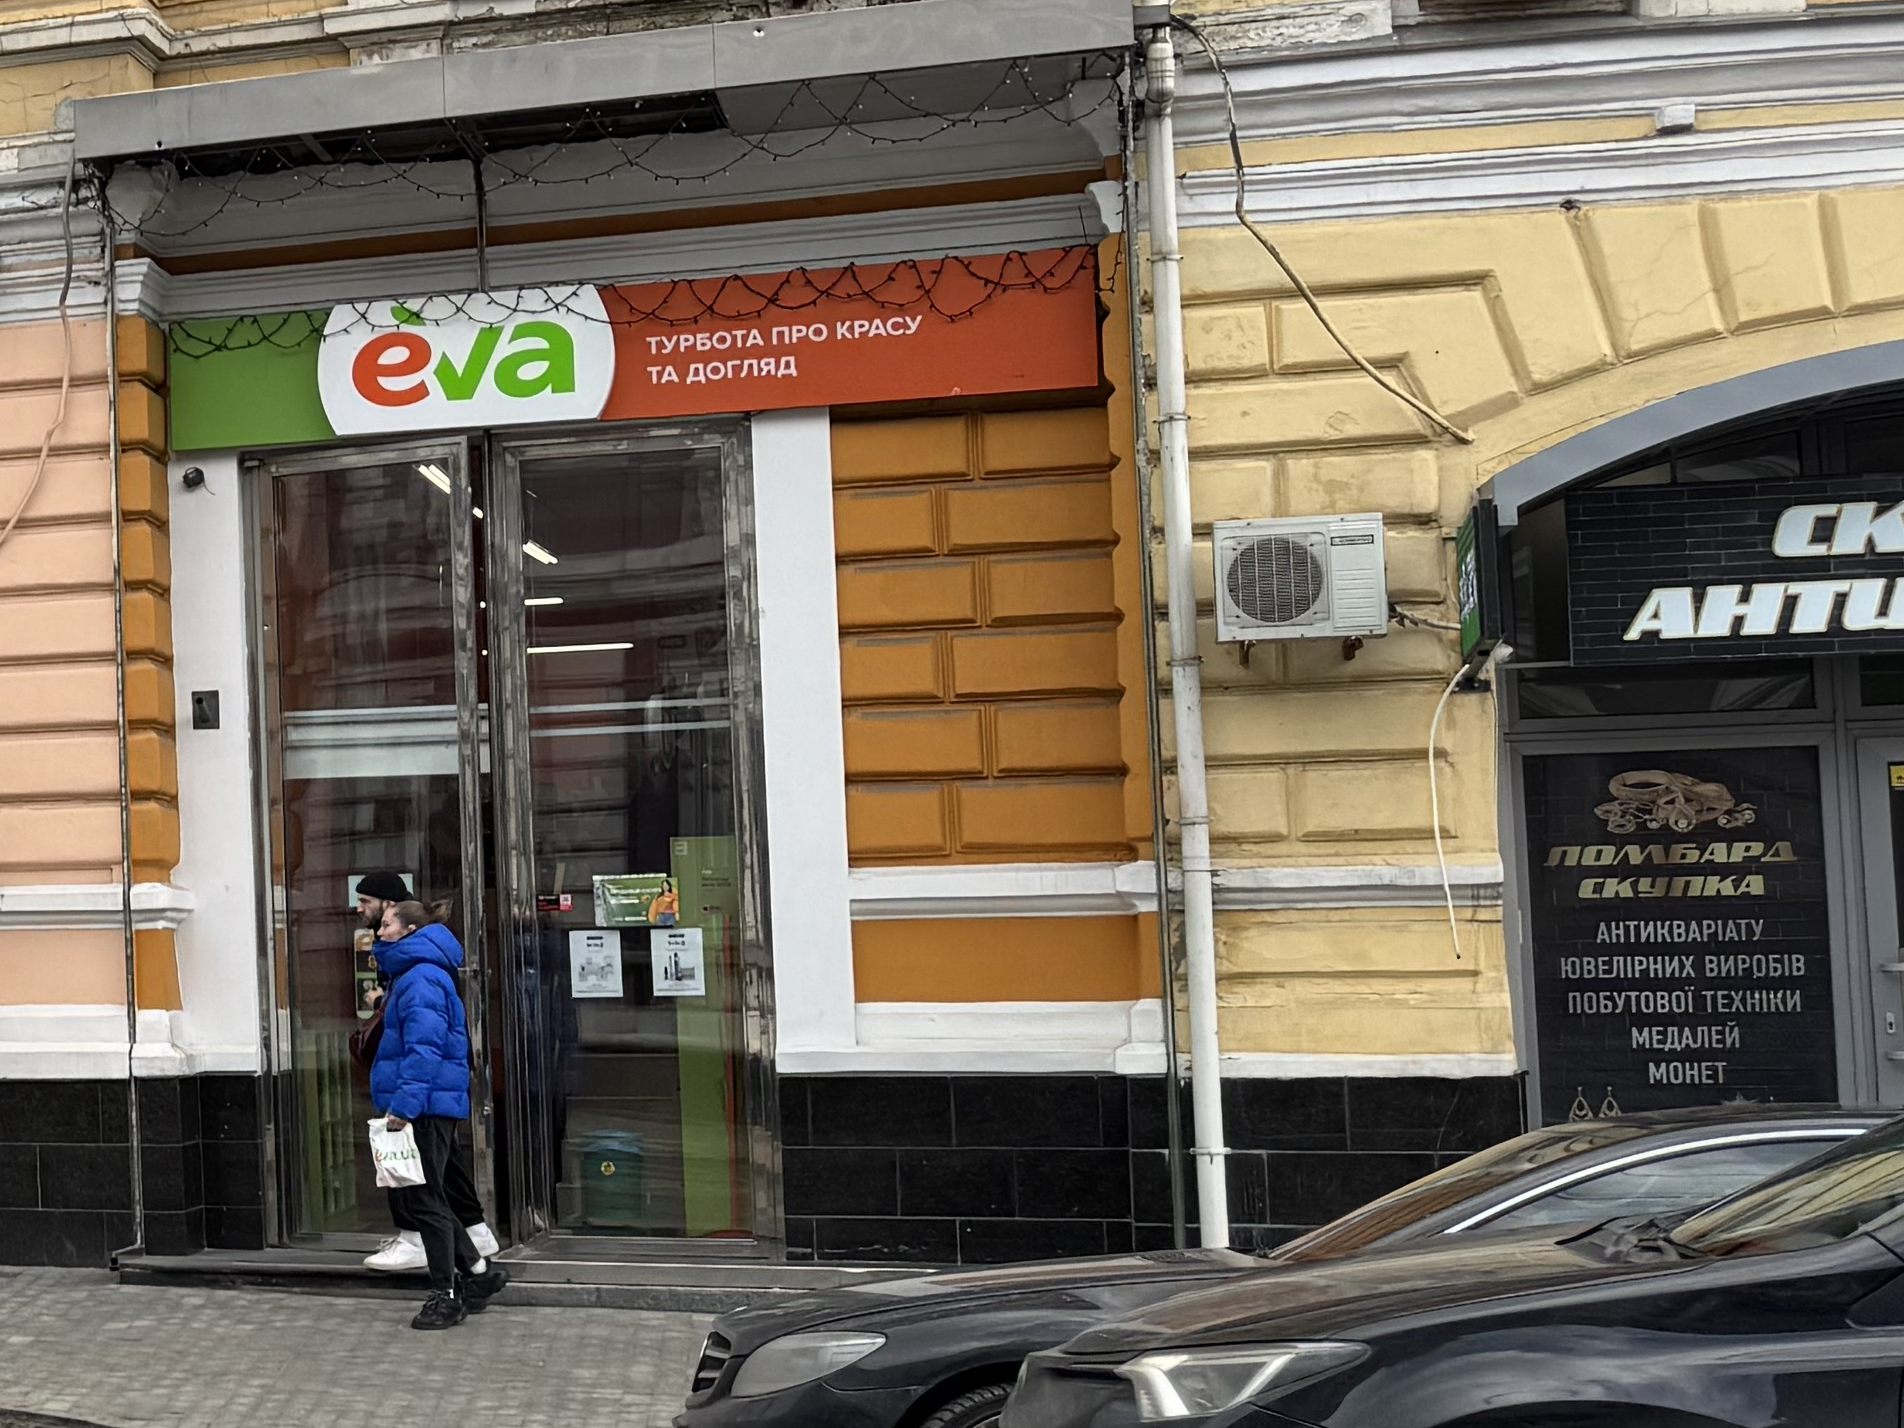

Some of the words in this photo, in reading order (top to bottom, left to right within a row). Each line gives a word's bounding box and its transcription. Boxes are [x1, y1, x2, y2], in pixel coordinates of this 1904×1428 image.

[646, 328, 764, 355] ТУРБОТА
[771, 323, 828, 346] ПРО
[836, 315, 923, 340] КРАСУ
[352, 320, 576, 407] eva
[646, 365, 679, 384] ТА
[686, 356, 797, 385] ДОГЛЯД
[1544, 841, 1798, 866] ЛОМБАРД
[1578, 875, 1765, 898] СКУПКА
[1597, 919, 1764, 944] АНТИКВАРІАТУ
[1560, 955, 1696, 979] ЮВЕЛІРНИХ
[1705, 953, 1805, 978] ВИРОБІВ
[1568, 985, 1695, 1014] ПОБУТОВОЇ
[1701, 989, 1802, 1013] ТЕХНІКИ
[1632, 1022, 1740, 1051] МЕДАЛЕЙ
[1648, 1062, 1728, 1085] МОНЕТ
